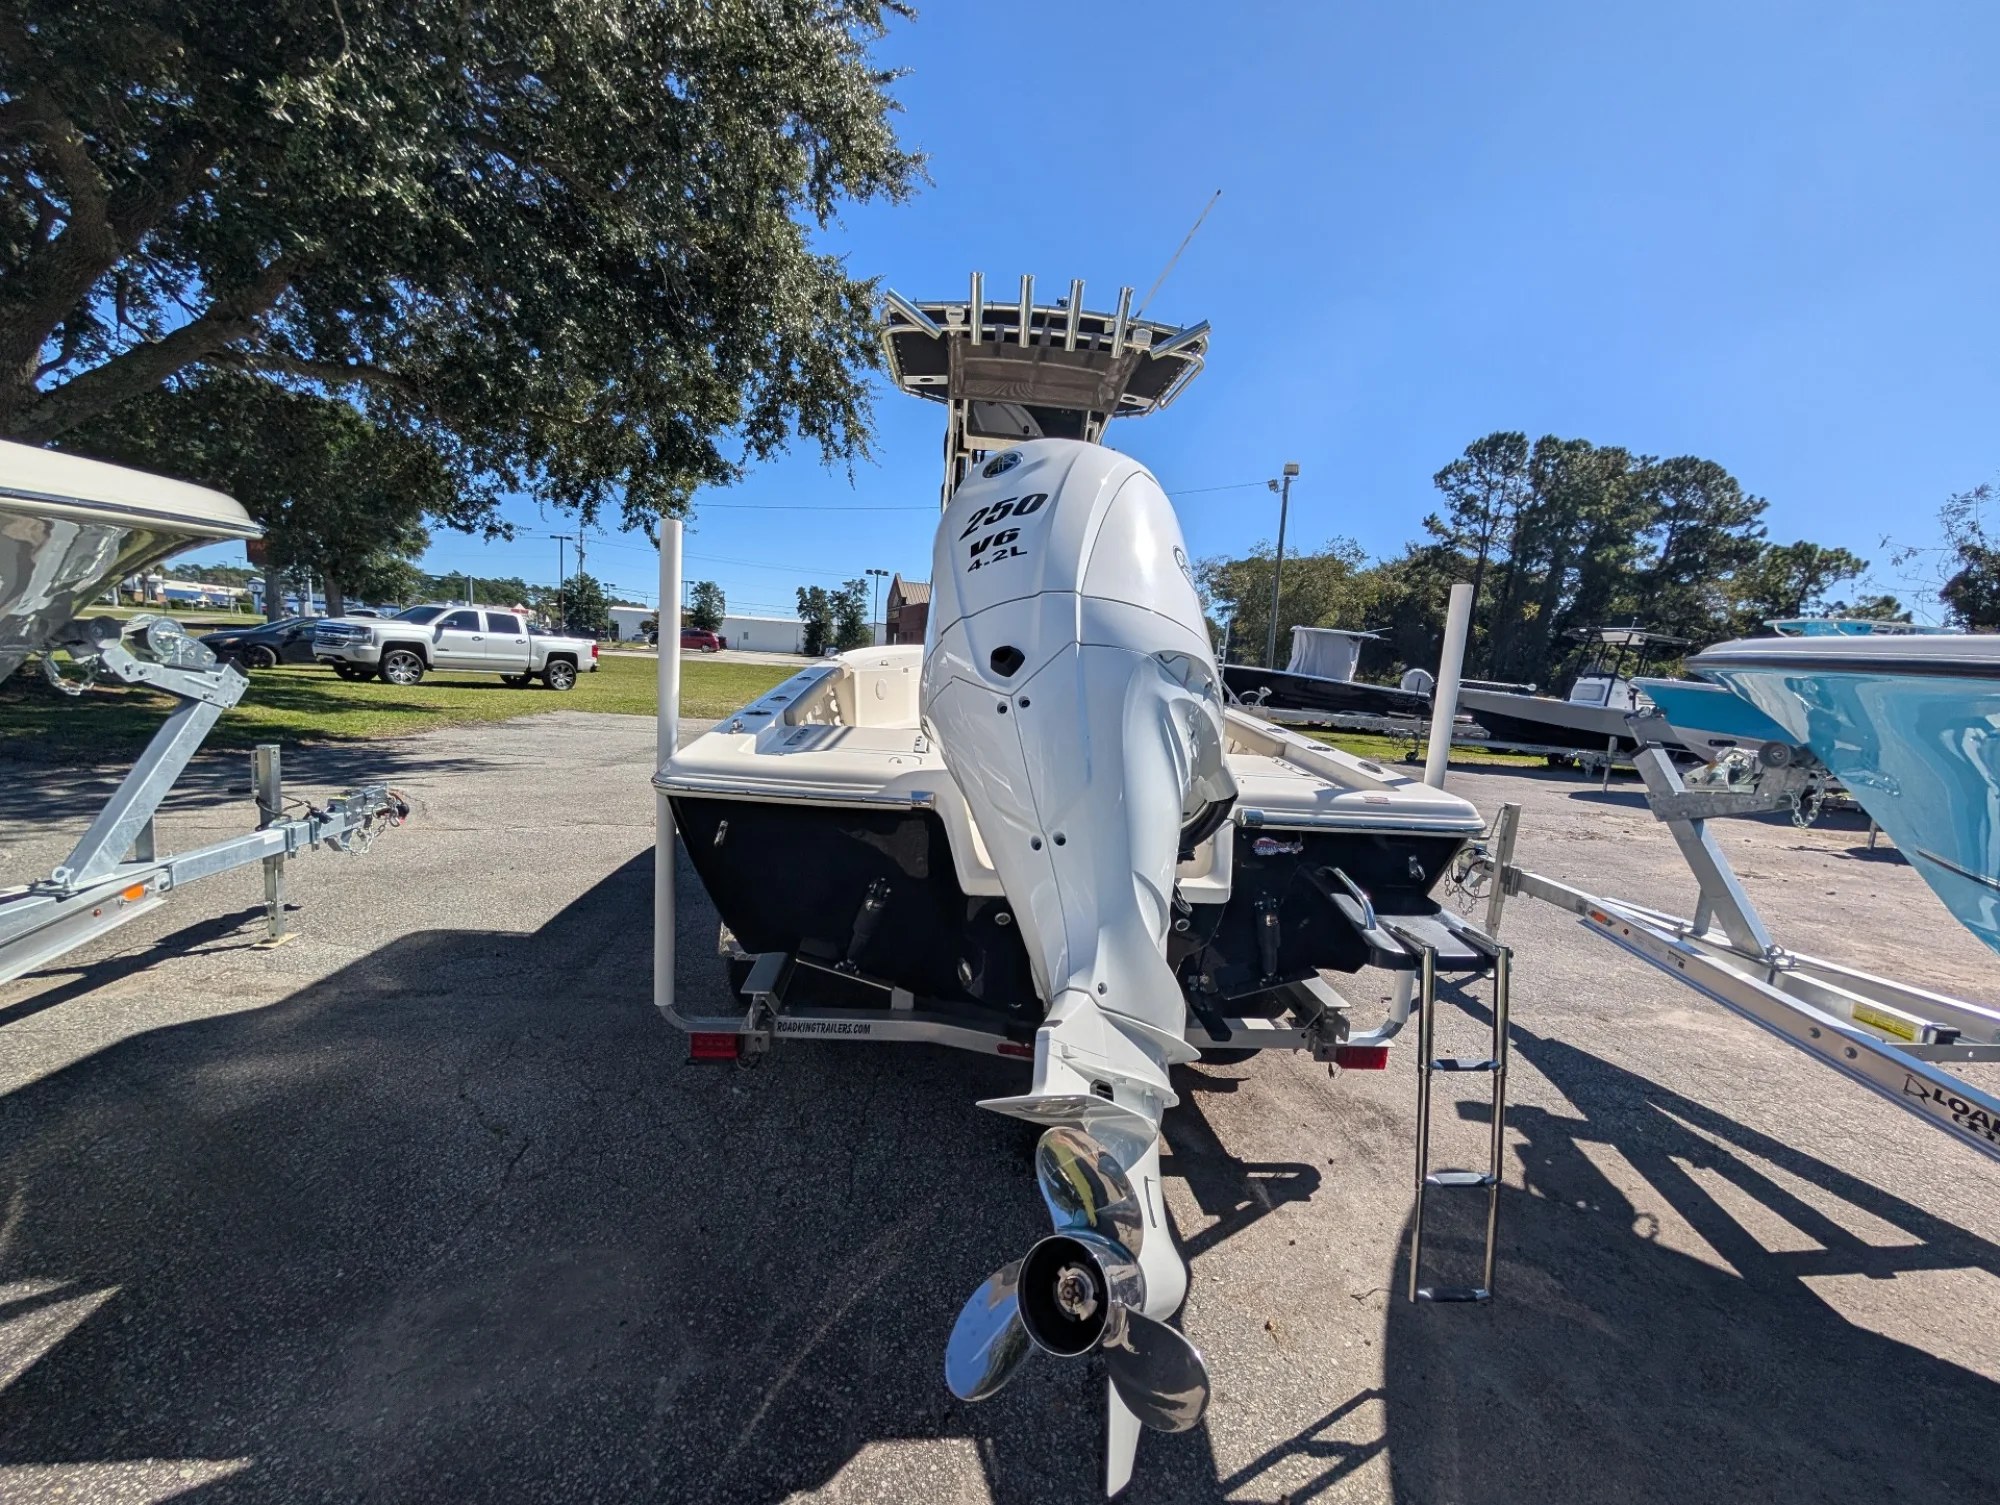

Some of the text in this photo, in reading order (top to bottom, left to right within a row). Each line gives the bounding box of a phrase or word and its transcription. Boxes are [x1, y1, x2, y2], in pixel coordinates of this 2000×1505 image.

[959, 493, 1049, 541] 250
[970, 527, 1021, 558] V6
[967, 546, 1028, 573] 4.2L
[777, 1021, 871, 1034] ROADKINGTRAILERS.COM
